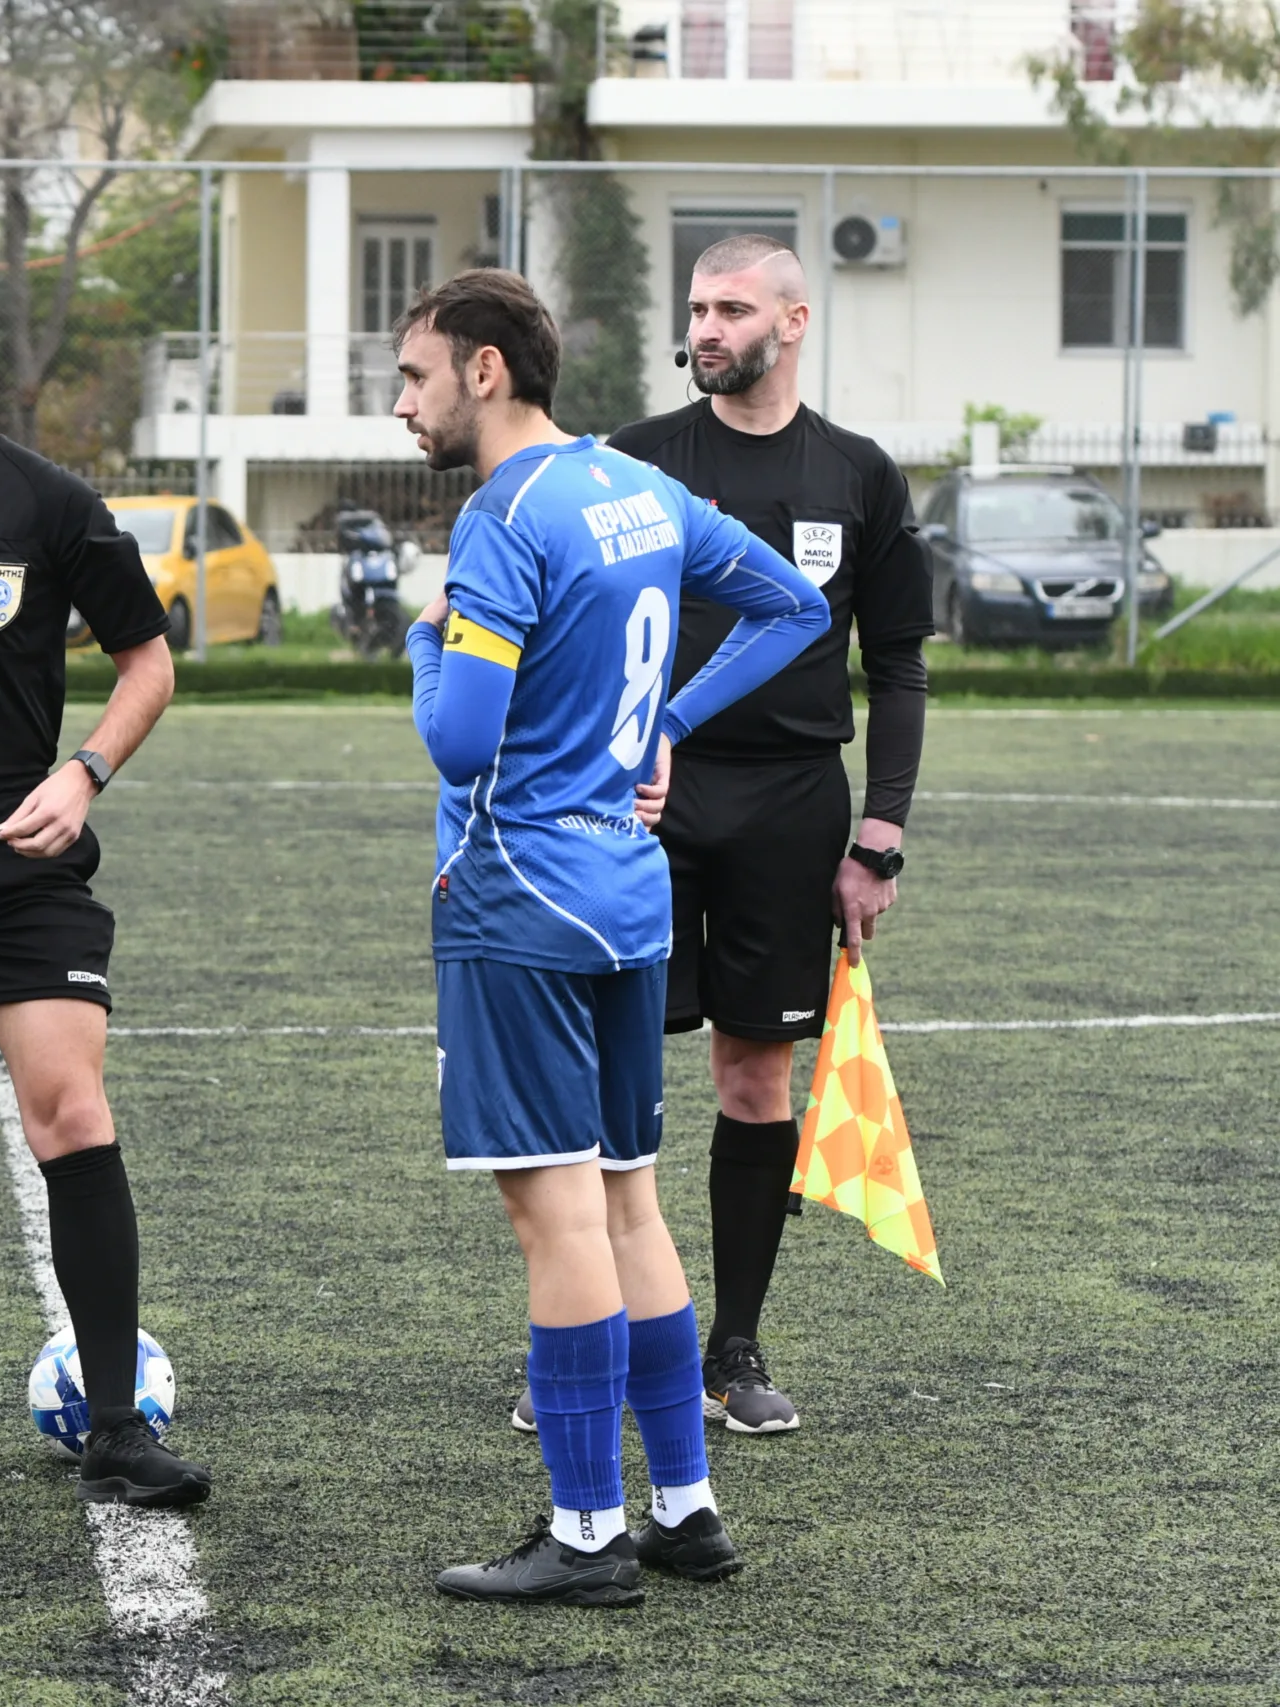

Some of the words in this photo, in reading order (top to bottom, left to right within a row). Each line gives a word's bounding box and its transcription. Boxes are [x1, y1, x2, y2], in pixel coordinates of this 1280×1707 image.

[803, 529, 832, 542] UEFA
[804, 549, 832, 558] MATCH
[800, 558, 835, 568] OFFICIAL
[608, 586, 670, 772] 8
